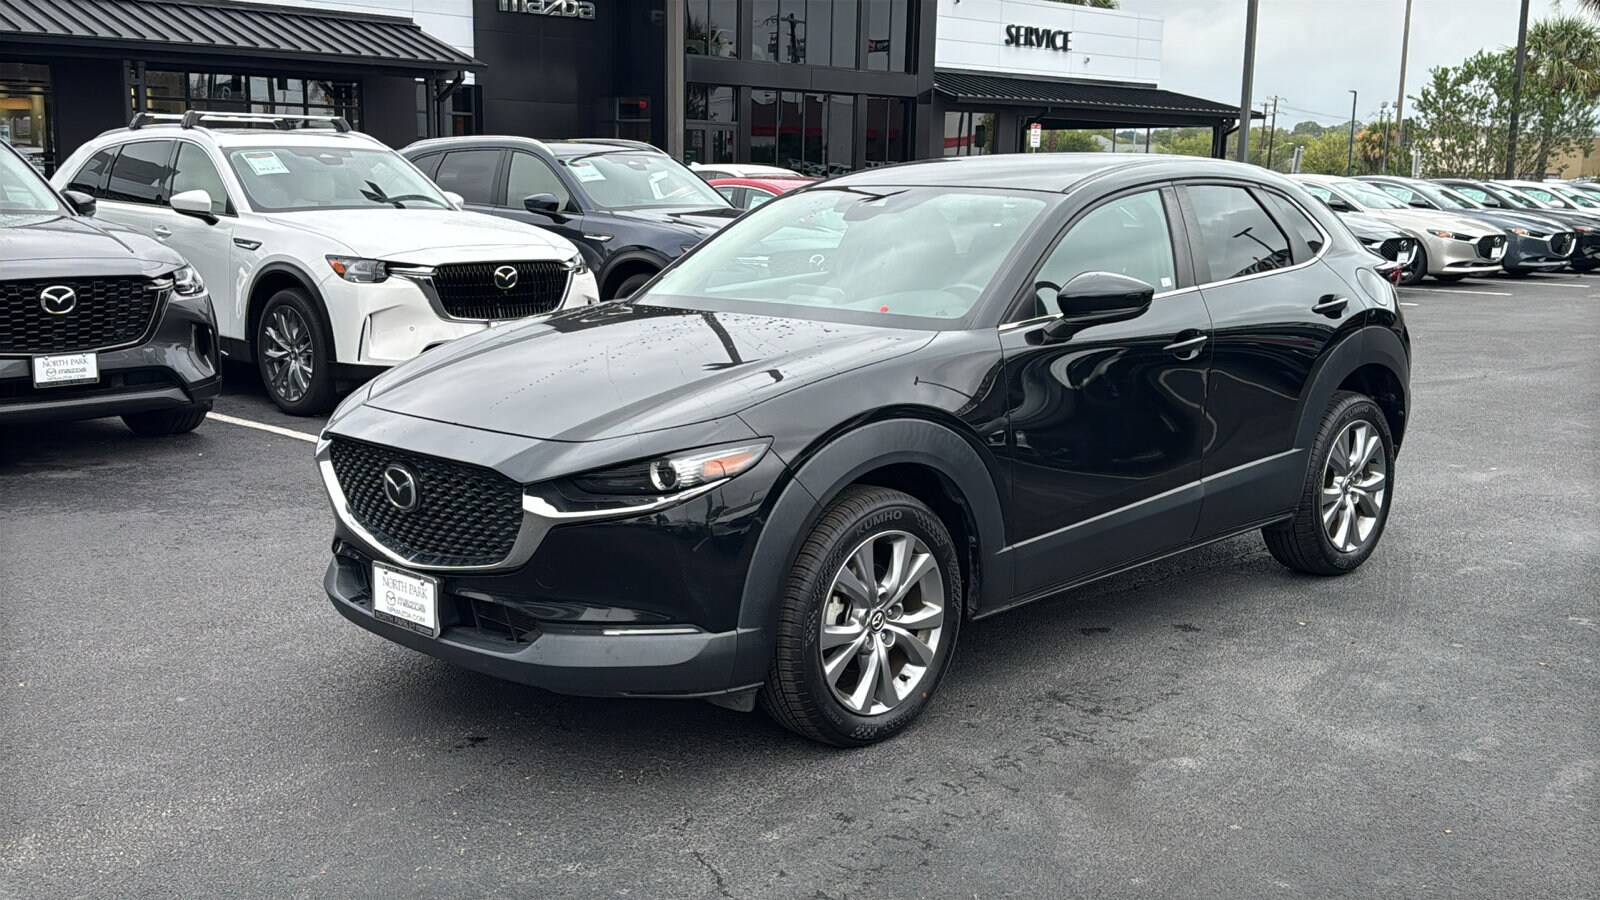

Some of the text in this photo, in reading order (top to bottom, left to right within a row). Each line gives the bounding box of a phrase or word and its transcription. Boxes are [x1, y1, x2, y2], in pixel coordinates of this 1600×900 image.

[499, 0, 596, 20] mazda
[1004, 24, 1073, 52] SERVICE
[42, 358, 88, 368] NORTH PARK
[856, 510, 902, 537] KUMHO
[382, 575, 428, 600] NORTH PARK
